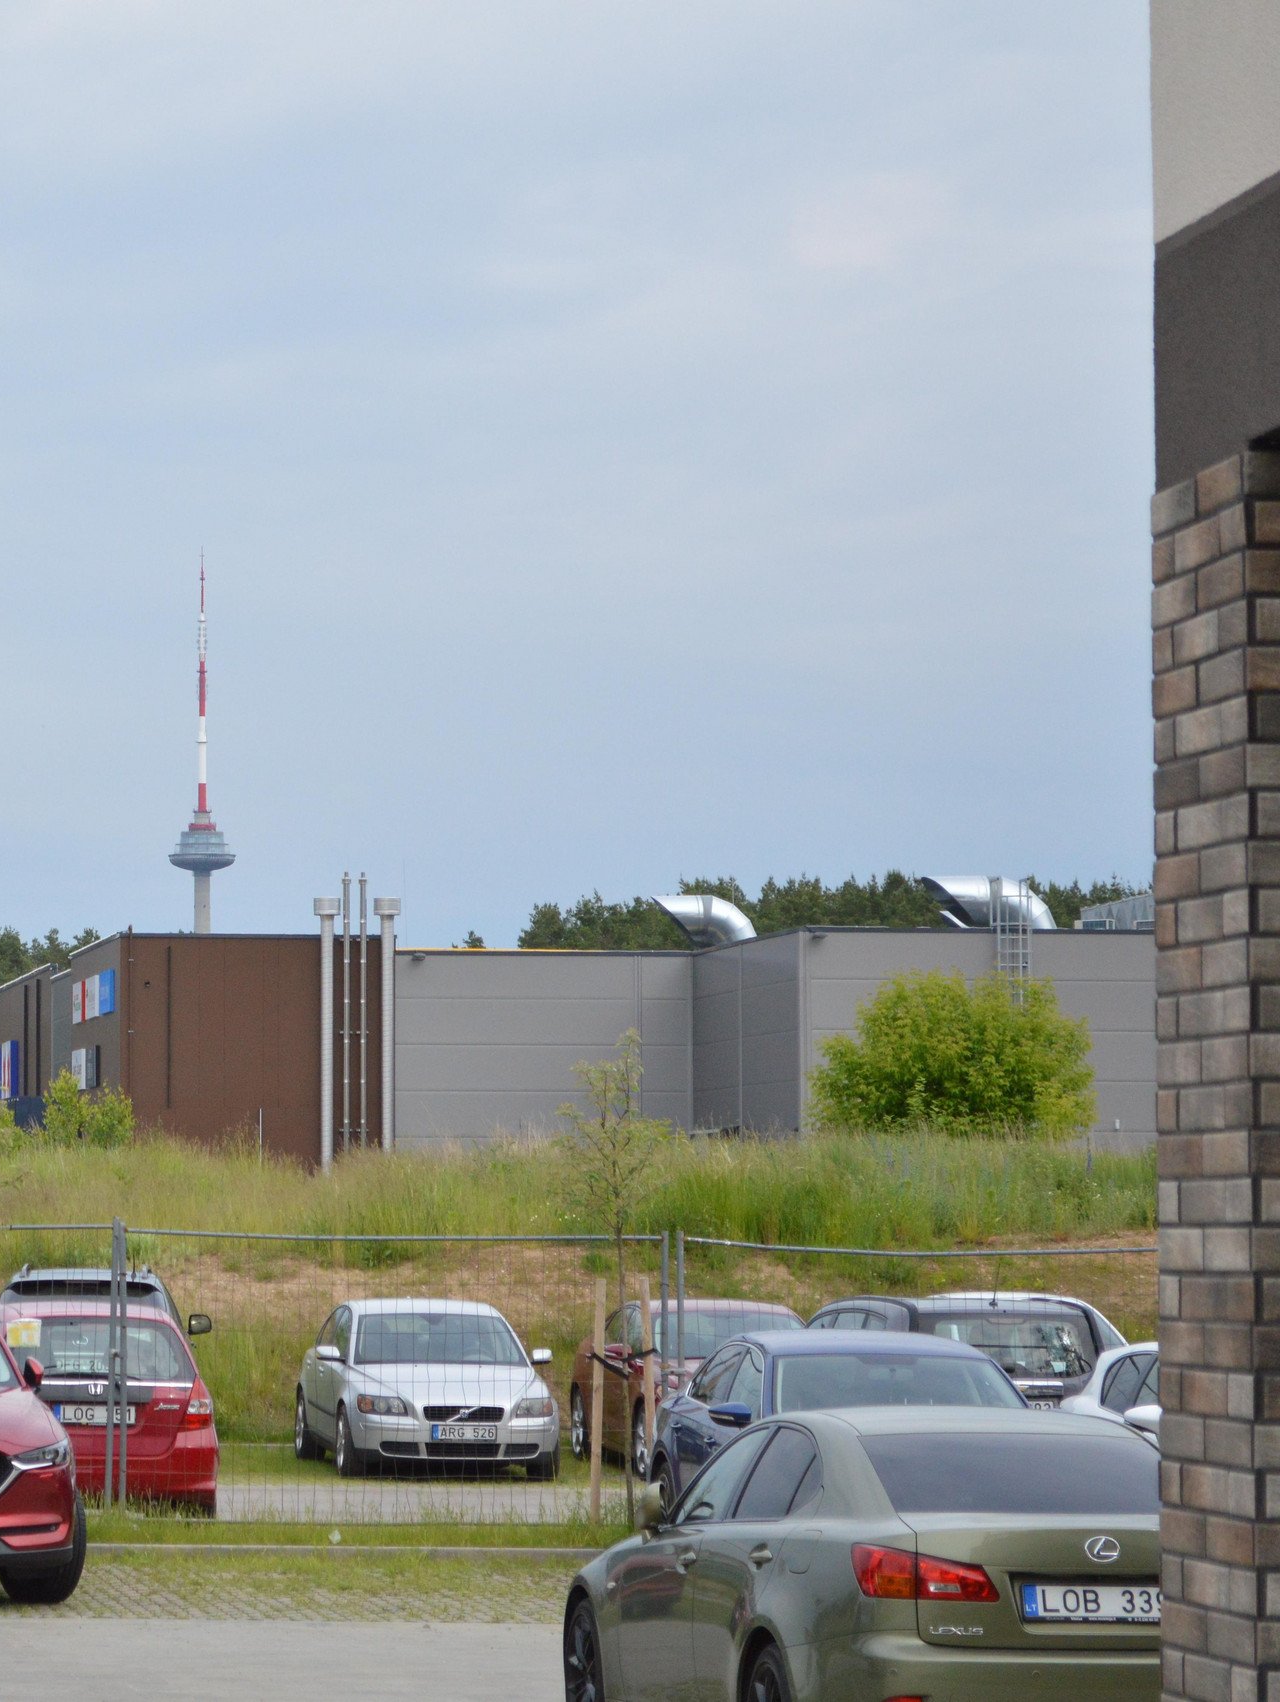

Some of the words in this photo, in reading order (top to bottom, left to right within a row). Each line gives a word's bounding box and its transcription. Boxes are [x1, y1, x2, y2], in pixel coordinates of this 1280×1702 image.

[62, 1407, 95, 1421] LOG
[106, 1408, 132, 1422] 51
[440, 1427, 465, 1438] ARG
[473, 1427, 495, 1439] 526
[1041, 1589, 1101, 1614] LOB
[1025, 1604, 1038, 1612] LT
[929, 1626, 984, 1636] LEXUS
